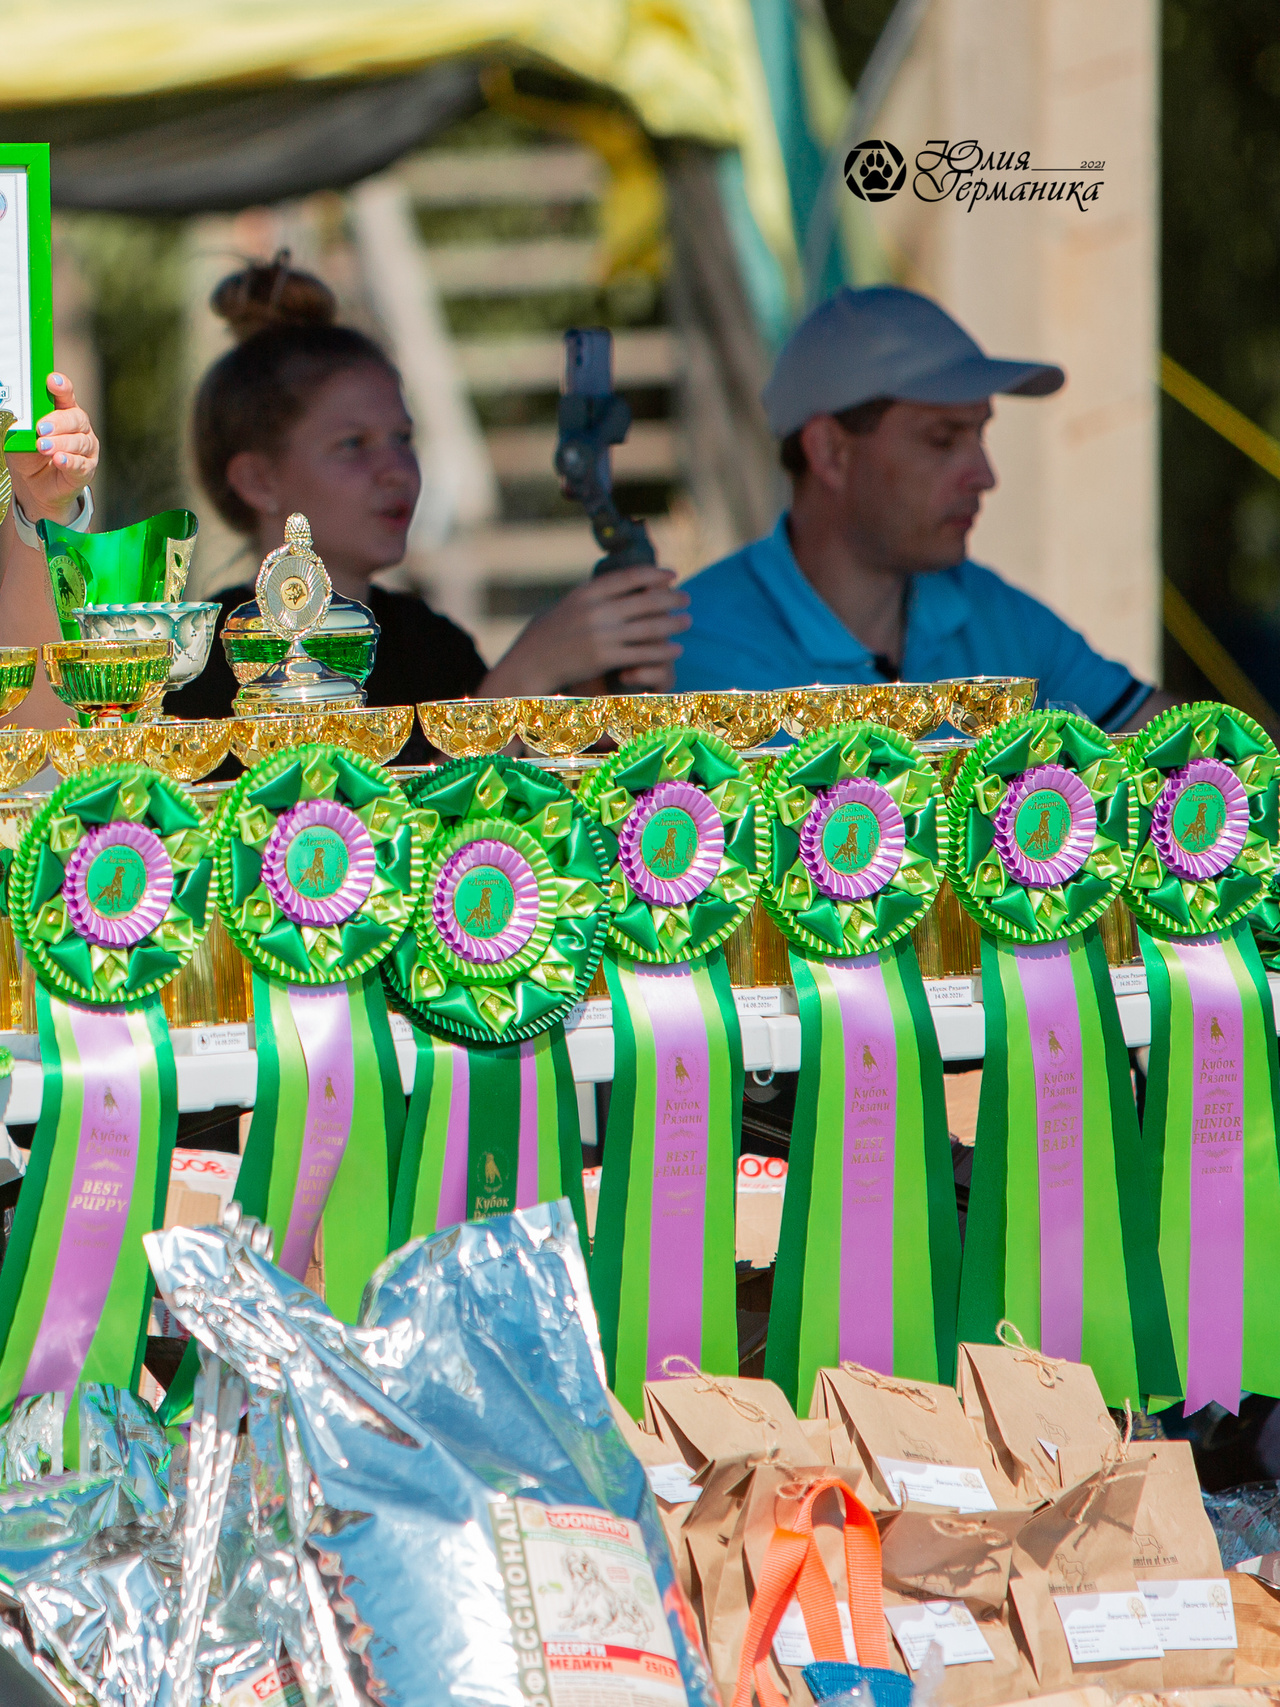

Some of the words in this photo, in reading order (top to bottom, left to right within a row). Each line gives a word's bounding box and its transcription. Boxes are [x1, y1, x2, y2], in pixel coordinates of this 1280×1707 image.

[1201, 1057, 1236, 1074] Кубок
[1043, 1071, 1076, 1087] Кубок
[1199, 1072, 1238, 1085] Рязани
[853, 1086, 889, 1102] Кубок
[1042, 1086, 1078, 1099] Рязани
[665, 1097, 701, 1114] Кубок
[851, 1100, 891, 1114] Рязани
[1203, 1102, 1234, 1116] BEST
[662, 1113, 703, 1126] Рязани
[1043, 1116, 1078, 1135] BEST
[1193, 1116, 1242, 1133] JUNIOR
[90, 1127, 131, 1146] Кубок
[854, 1136, 886, 1150] BEST
[1042, 1134, 1079, 1153] BABY
[1192, 1130, 1243, 1145] FEMALE
[665, 1150, 698, 1163] BEST
[850, 1150, 887, 1165] MALE
[654, 1164, 706, 1178] FEMALE
[81, 1179, 123, 1197] BEST
[70, 1193, 128, 1213] PUPPY
[475, 1194, 510, 1214] Кубок
[546, 1641, 607, 1658] АССОРТИ
[549, 1658, 614, 1673] МЕДИУМ
